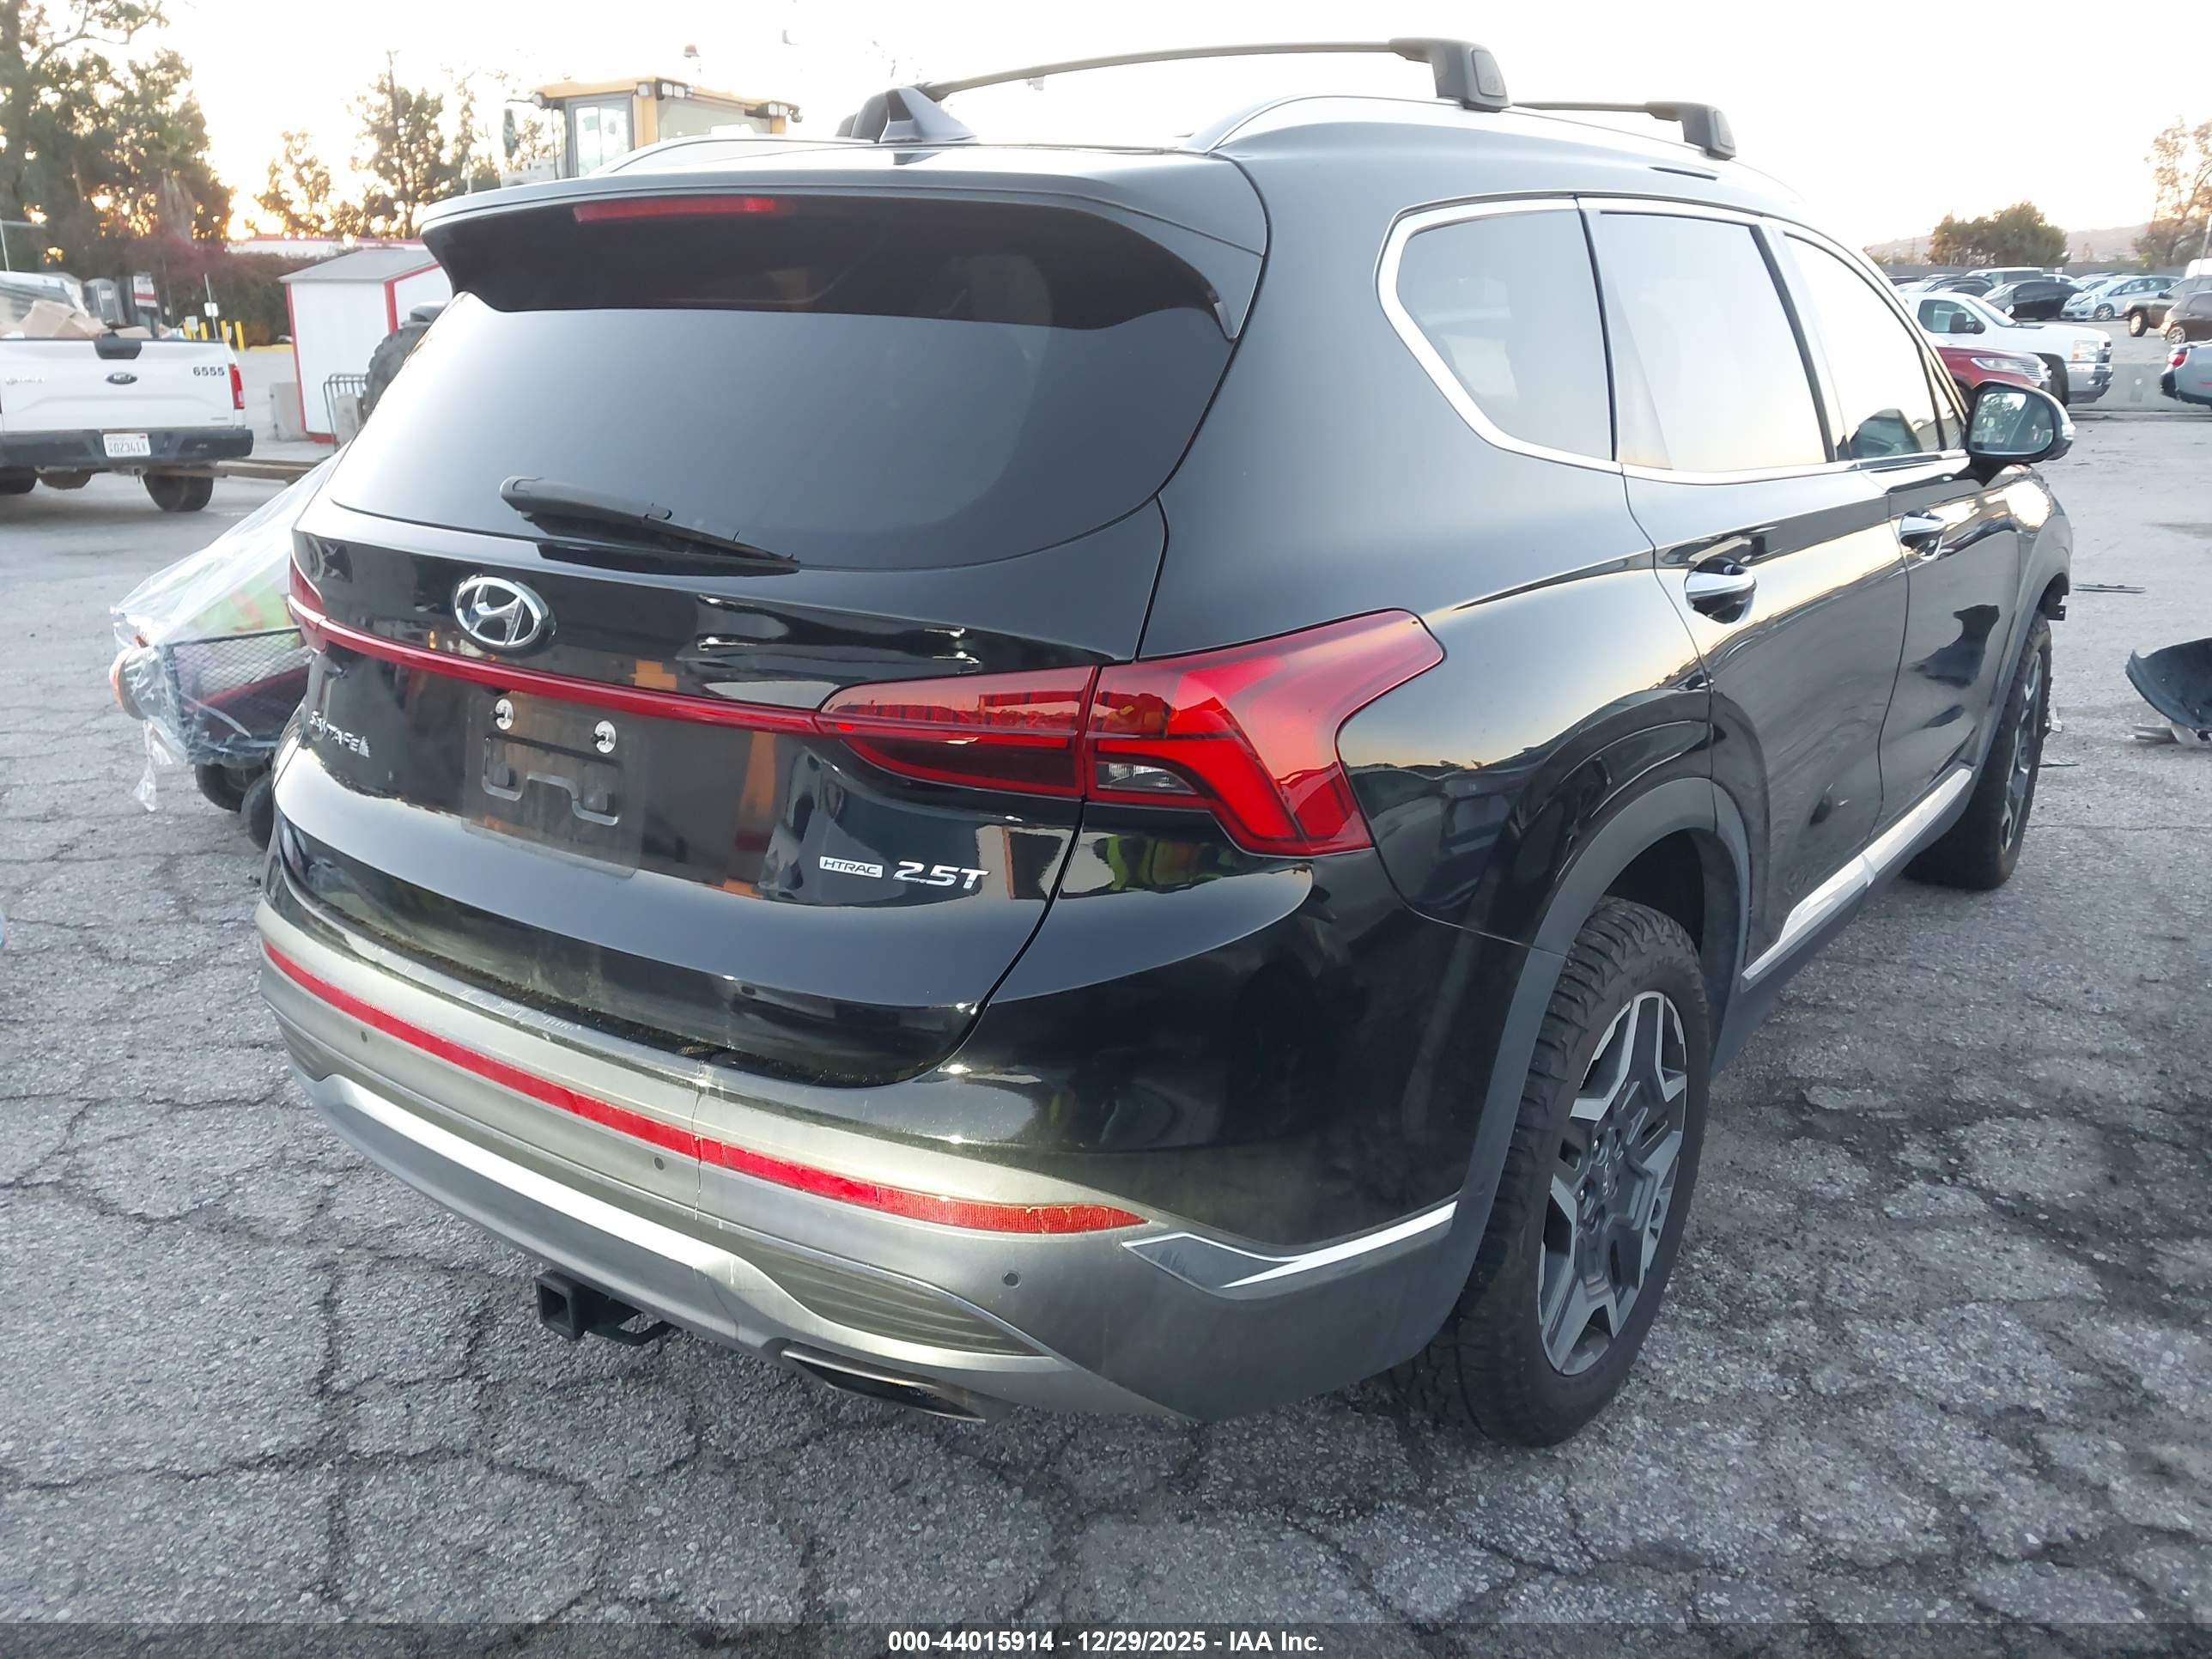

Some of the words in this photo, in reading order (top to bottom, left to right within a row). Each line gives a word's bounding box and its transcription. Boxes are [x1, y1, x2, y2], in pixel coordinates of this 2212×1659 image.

[192, 366, 226, 377] 6555
[823, 859, 878, 876] HTRAC
[893, 860, 990, 890] 2.5T
